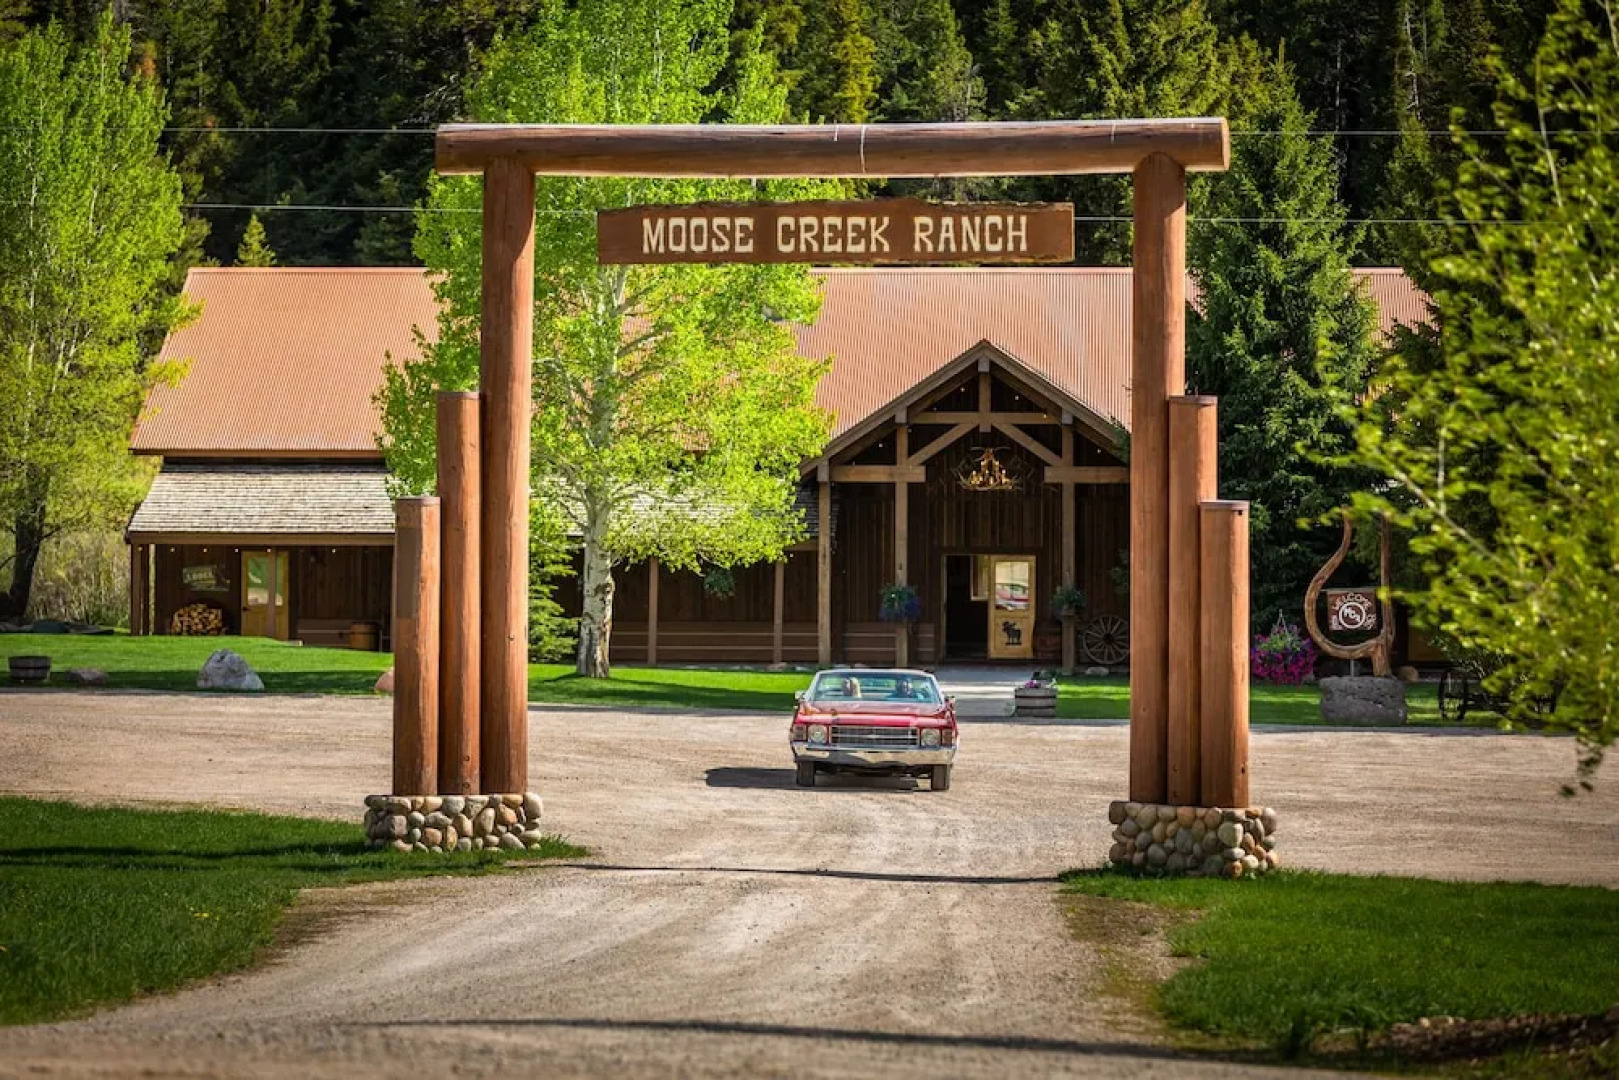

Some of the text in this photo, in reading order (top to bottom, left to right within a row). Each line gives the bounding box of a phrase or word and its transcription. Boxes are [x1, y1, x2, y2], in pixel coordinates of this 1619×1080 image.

[642, 215, 1027, 253] MOOSE CREEK RANCH
